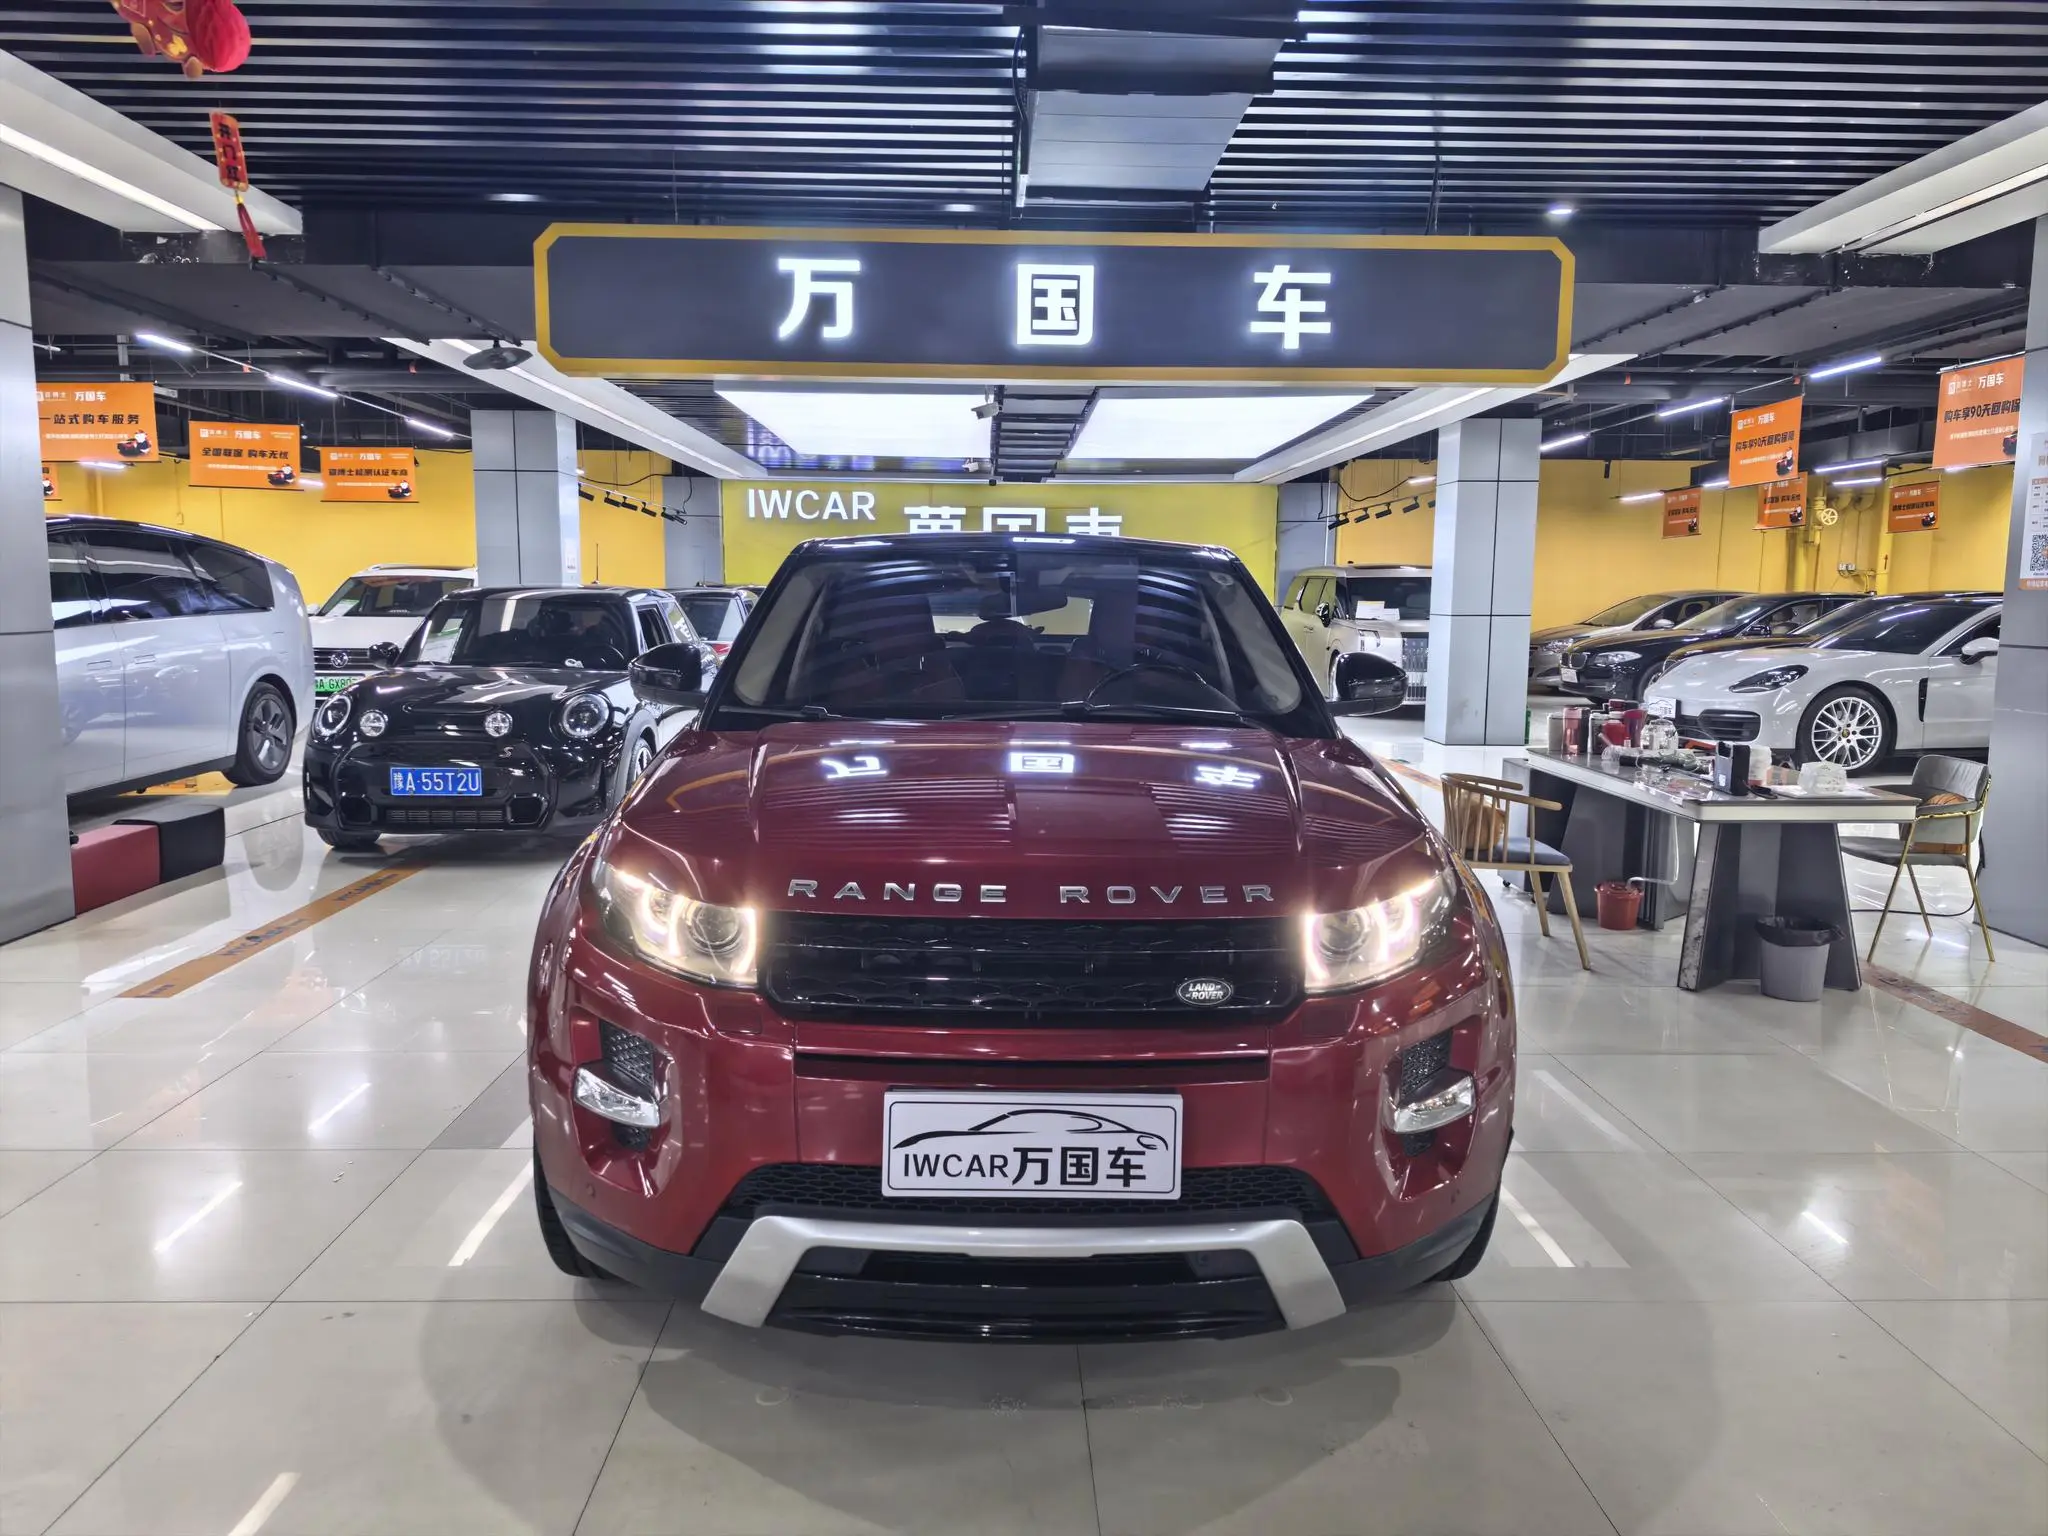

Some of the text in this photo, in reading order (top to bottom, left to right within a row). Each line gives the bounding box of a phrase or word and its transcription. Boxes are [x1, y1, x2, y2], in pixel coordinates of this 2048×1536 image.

[777, 257, 1332, 350] 万国车
[1978, 373, 2005, 389] 万国车
[75, 391, 106, 401] 万国车
[40, 414, 139, 424] 一站式购车服务
[747, 488, 876, 520] IWCAR
[787, 879, 1275, 904] RANGE ROVER
